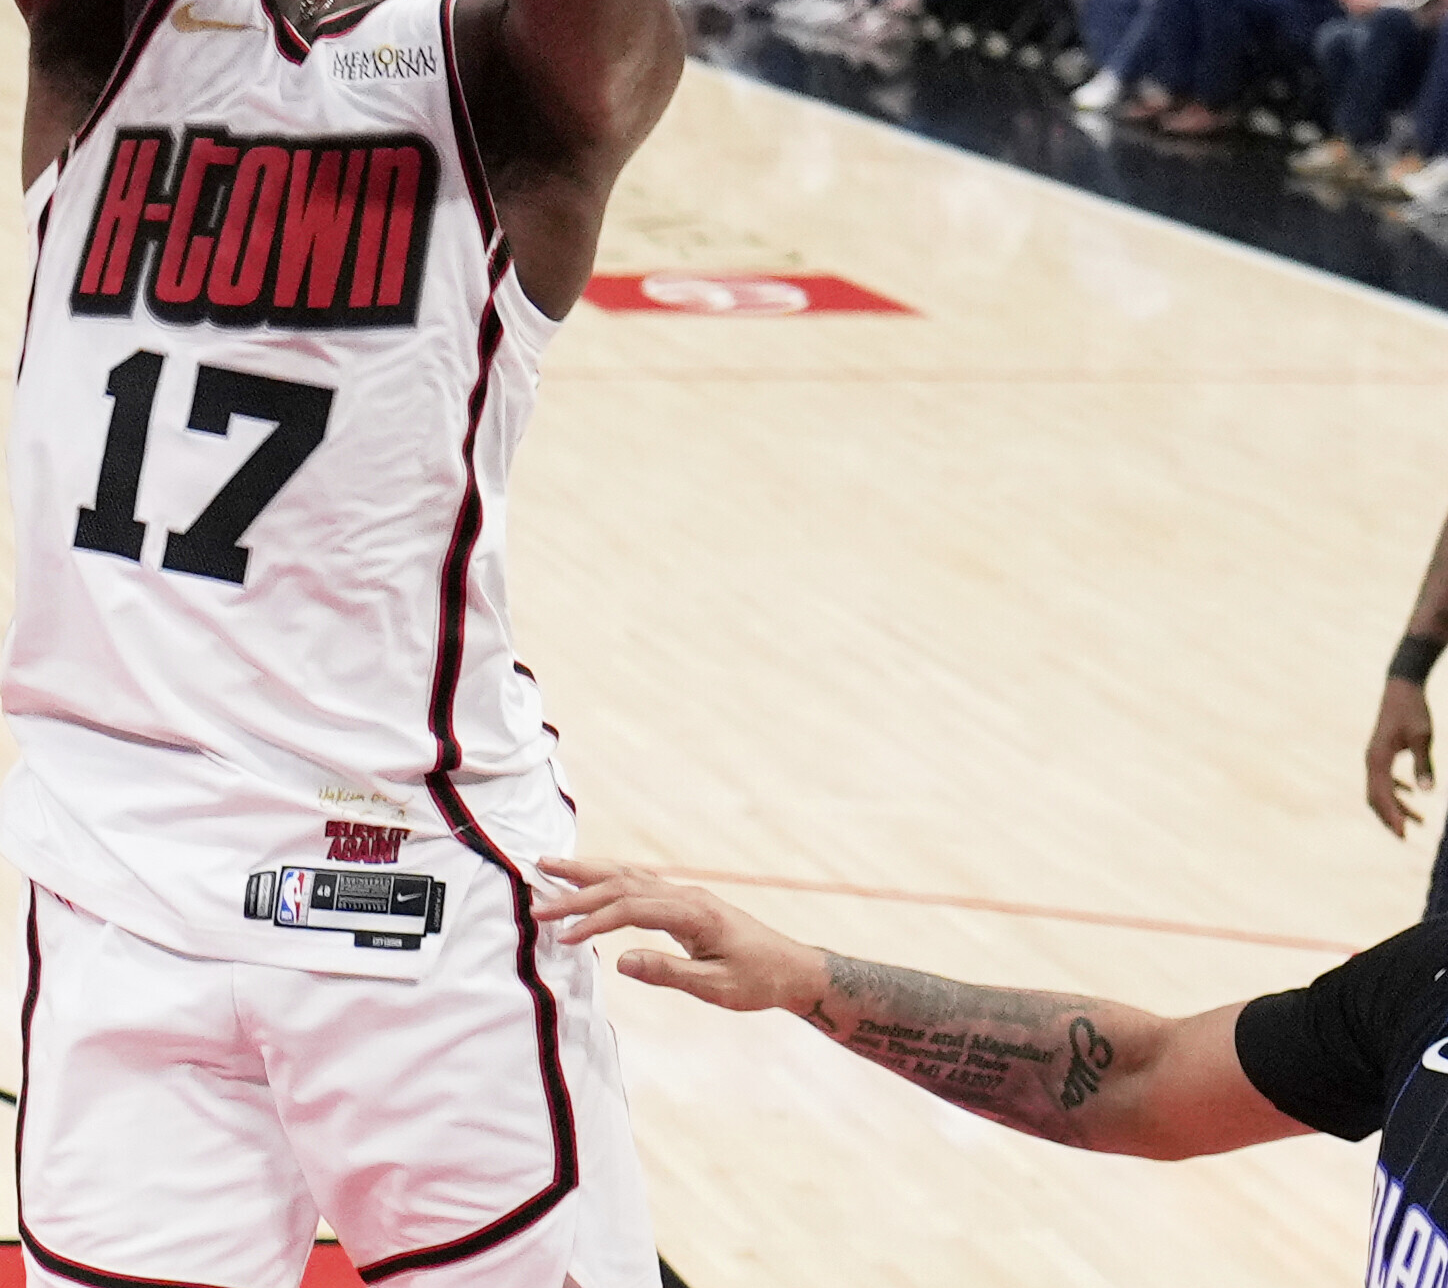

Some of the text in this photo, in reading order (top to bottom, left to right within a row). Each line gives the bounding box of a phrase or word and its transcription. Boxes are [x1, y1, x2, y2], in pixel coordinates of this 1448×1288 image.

[335, 45, 437, 68] MEMORIAL
[333, 59, 436, 80] HERMANN
[72, 349, 337, 585] 17
